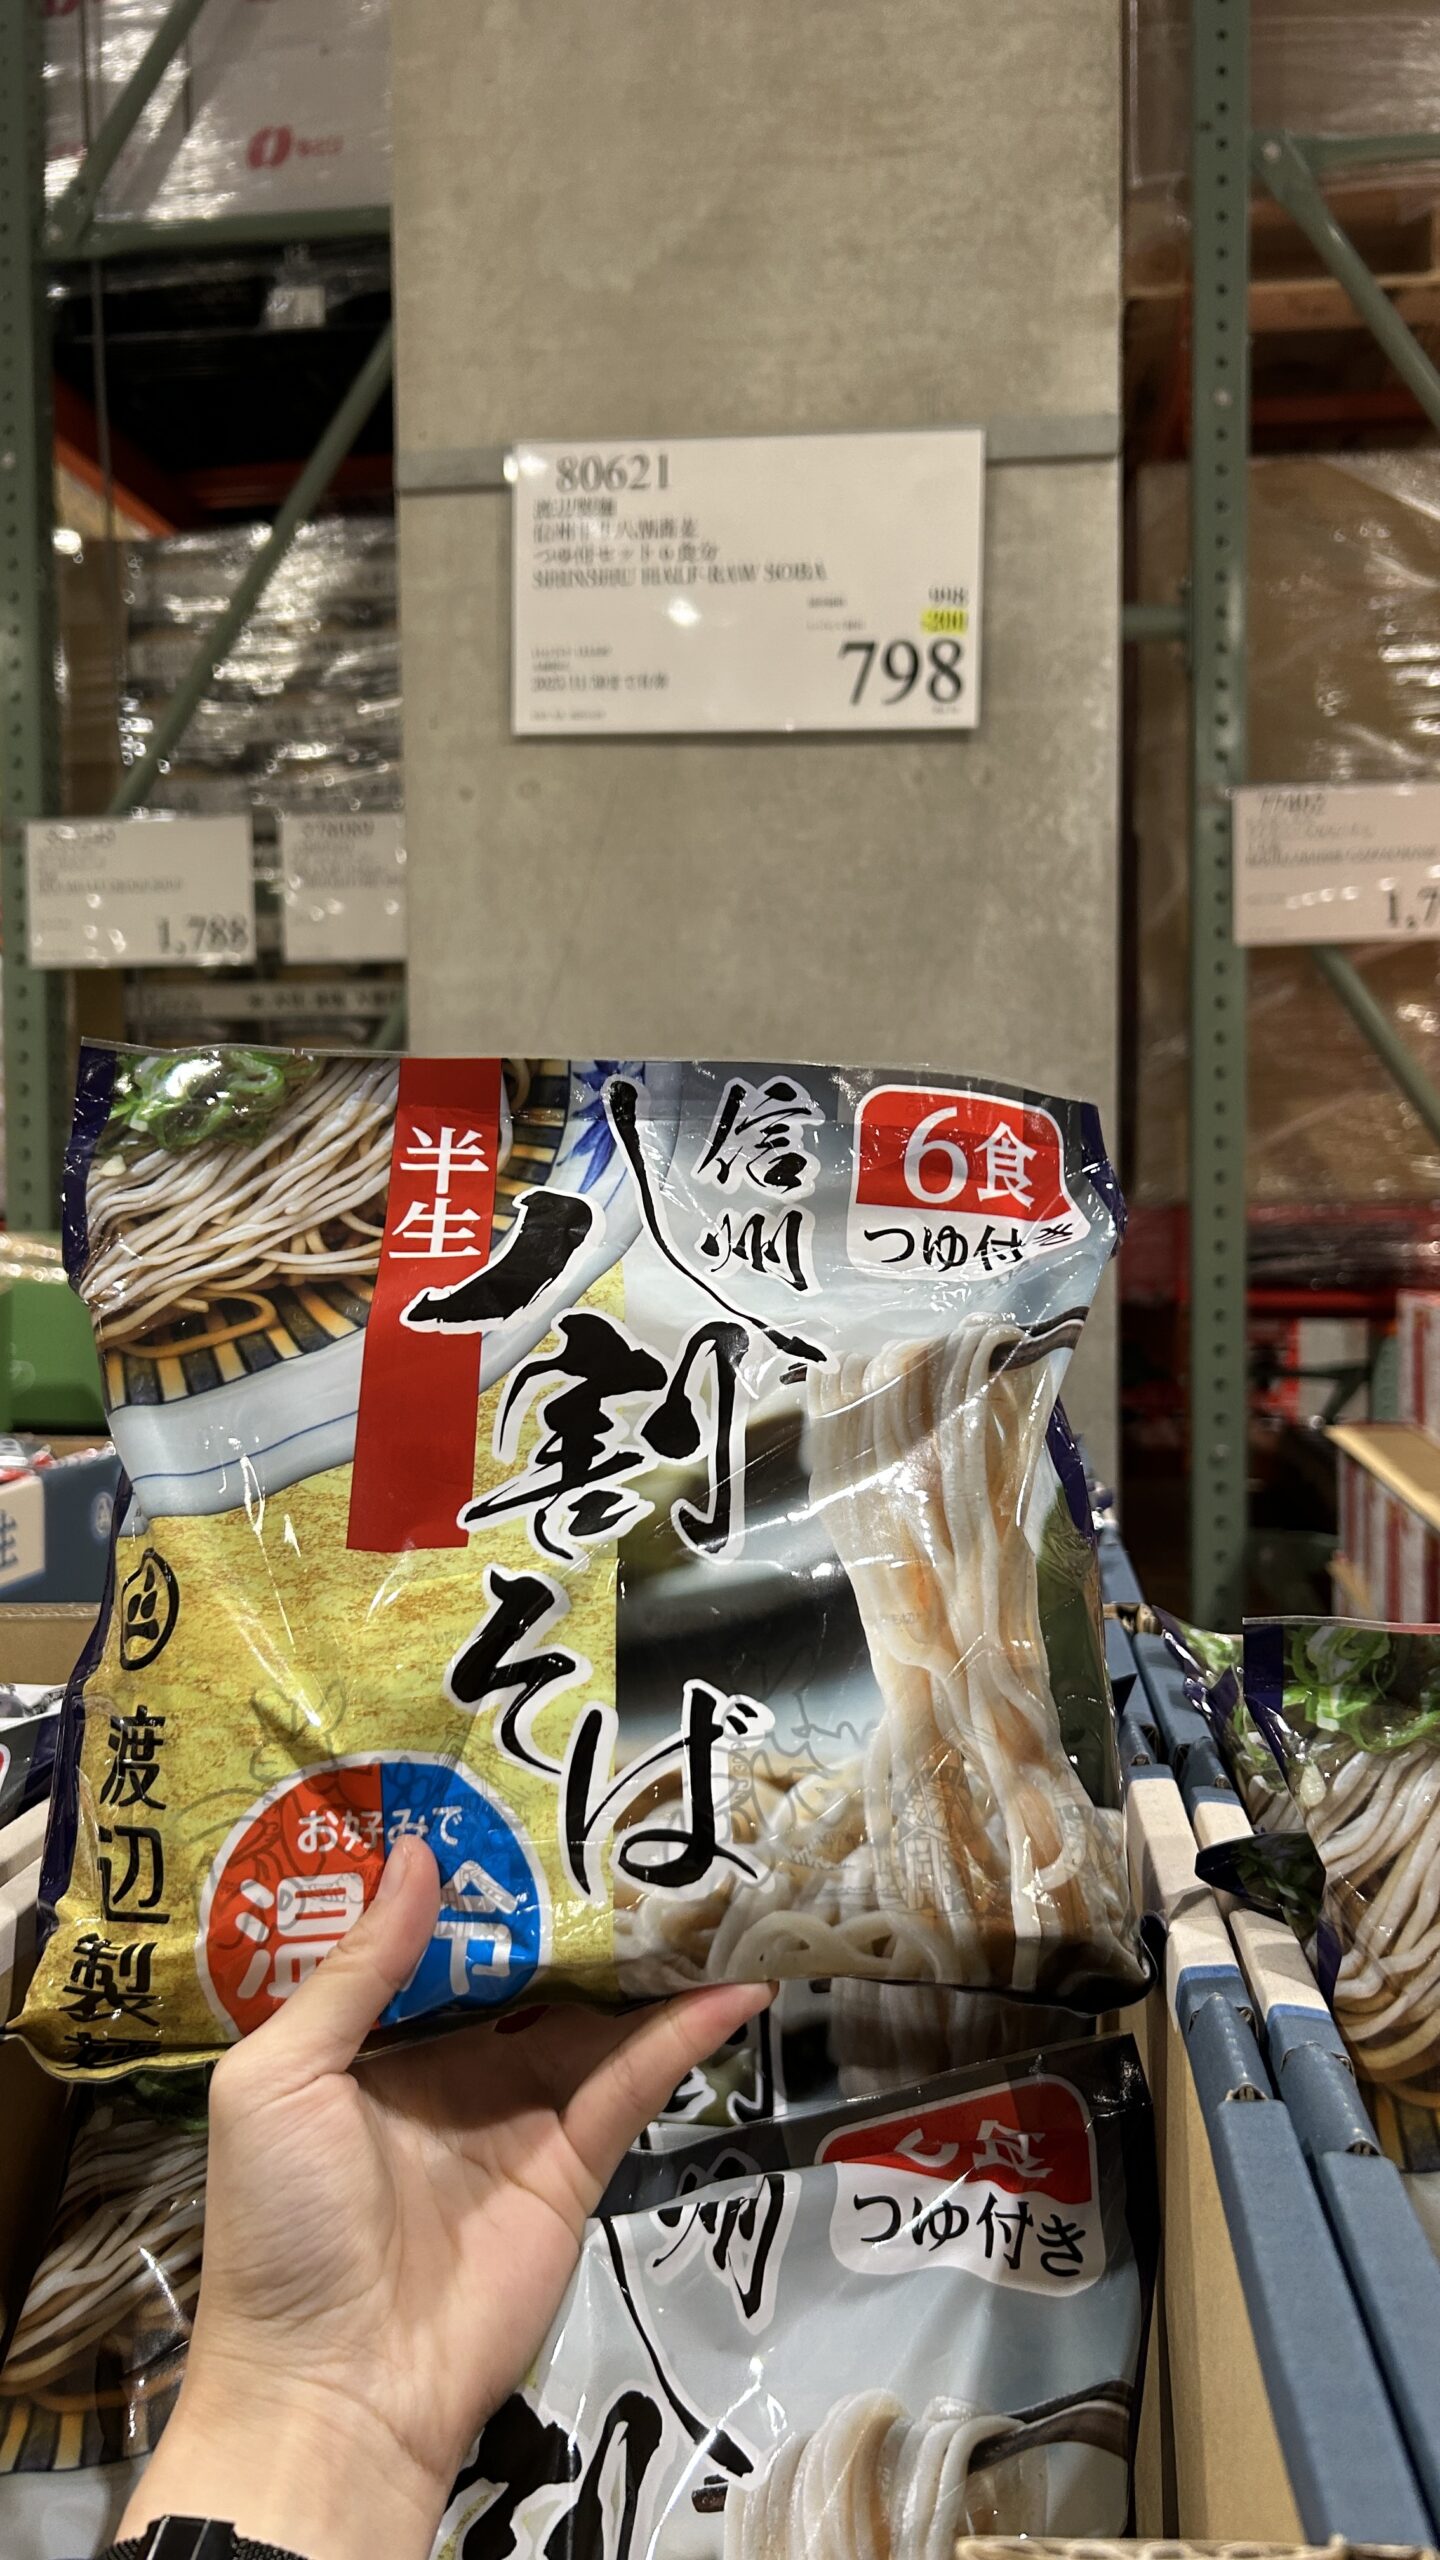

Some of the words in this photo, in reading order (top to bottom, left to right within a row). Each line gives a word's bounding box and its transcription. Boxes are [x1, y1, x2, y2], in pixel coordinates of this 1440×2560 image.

[556, 454, 669, 491] 80621
[763, 560, 829, 582] SOBA
[838, 638, 964, 707] 798
[156, 913, 249, 956] 1,788
[388, 1125, 490, 1261] 半生
[699, 1078, 824, 1292] 信州
[903, 1106, 1038, 1210] 6食
[408, 1080, 828, 1893] 八割そば
[296, 1805, 464, 1852] お好みで
[852, 2191, 1086, 2277] つゆ付き
